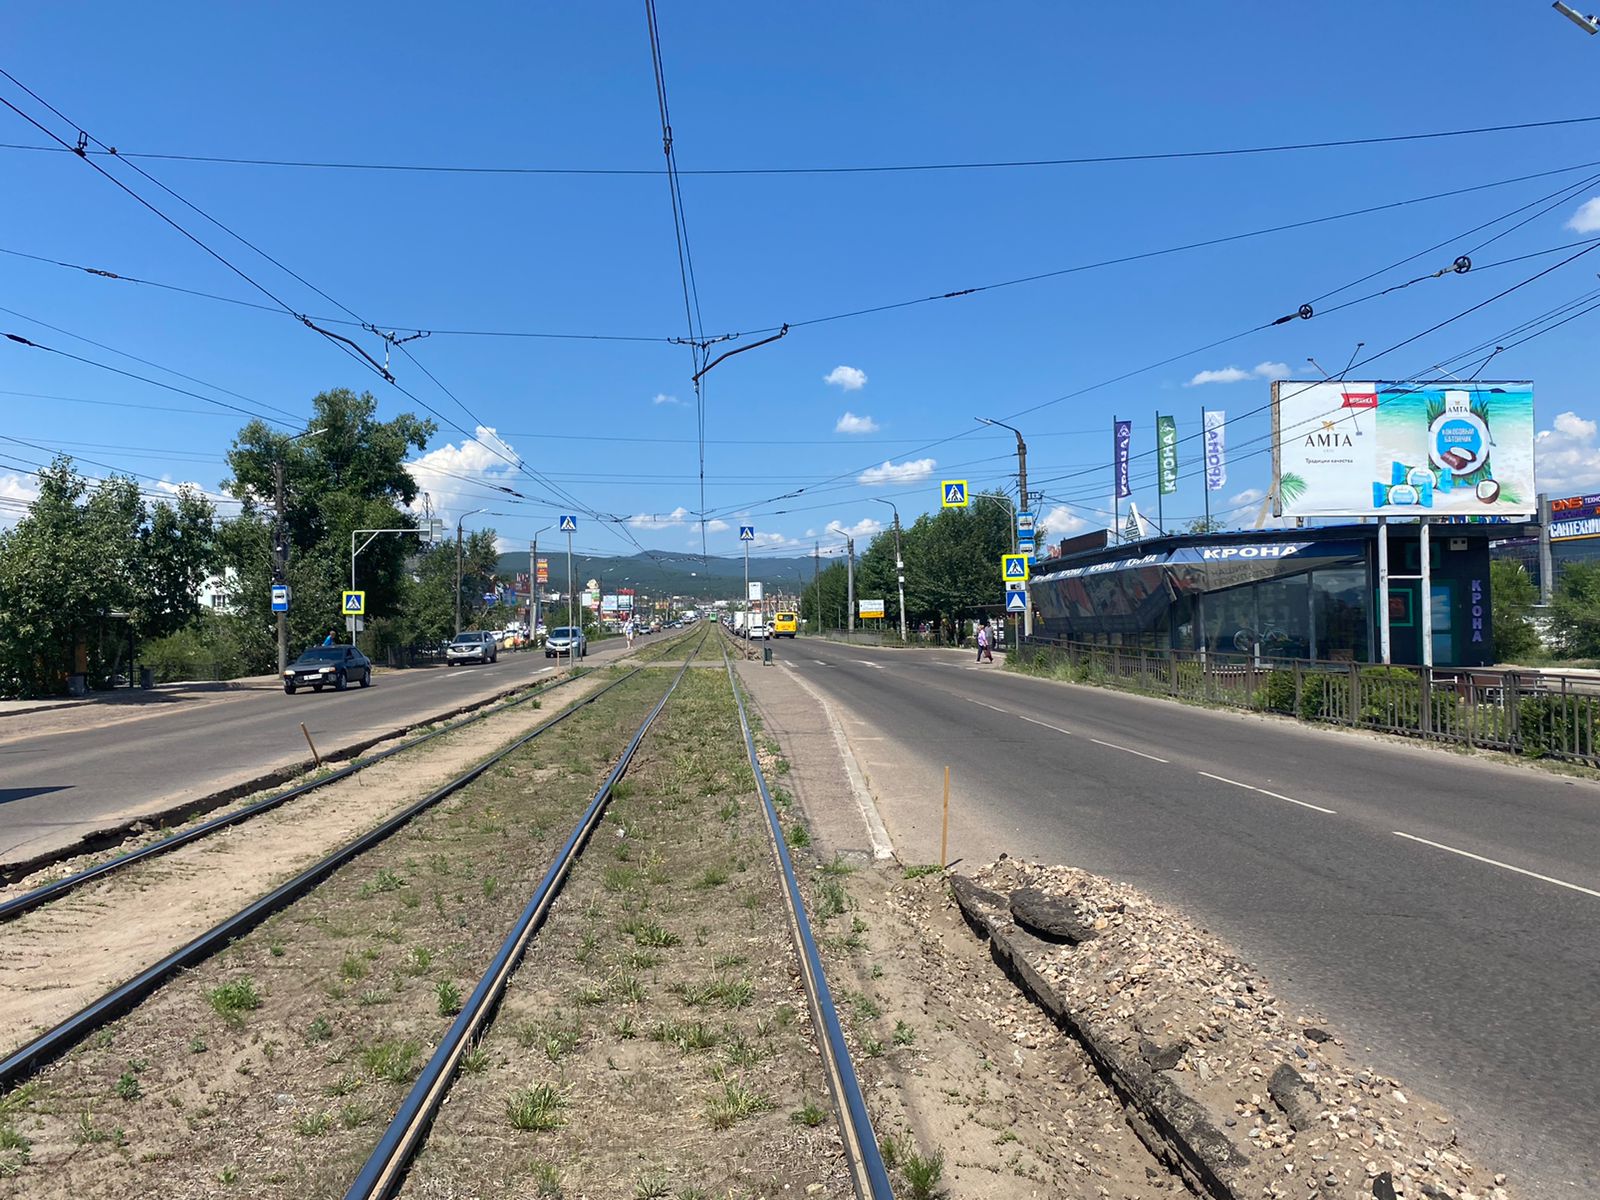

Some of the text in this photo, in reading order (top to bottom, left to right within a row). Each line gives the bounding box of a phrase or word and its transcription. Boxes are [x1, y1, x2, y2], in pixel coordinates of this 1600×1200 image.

[1163, 432, 1176, 492] КРОНА
[1552, 496, 1583, 511] DNS
[1550, 518, 1600, 537] САНТЕХНИ
[1203, 546, 1298, 558] КРОНА
[1089, 562, 1117, 573] КРОНА
[1472, 580, 1482, 642] КРОНА
